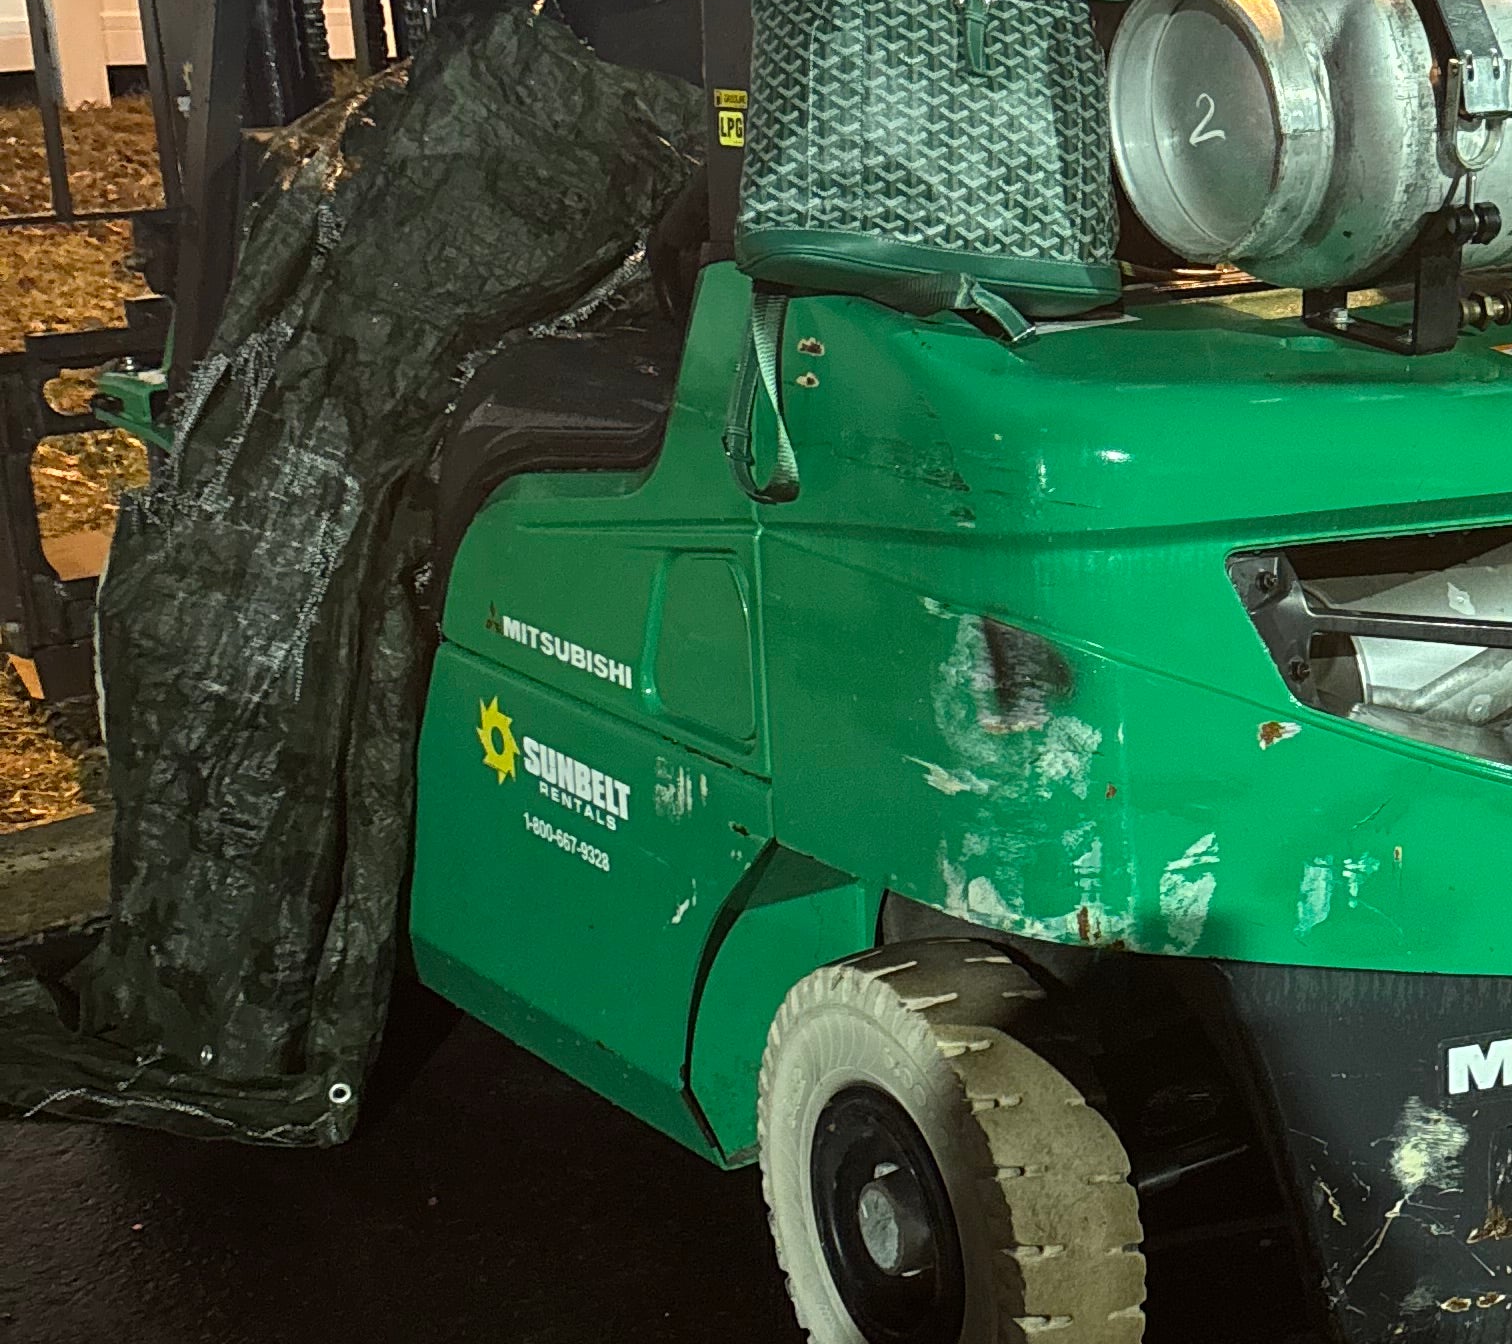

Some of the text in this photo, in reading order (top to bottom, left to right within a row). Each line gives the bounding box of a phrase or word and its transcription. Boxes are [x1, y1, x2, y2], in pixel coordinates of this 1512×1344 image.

[720, 116, 743, 139] LPG
[1188, 92, 1226, 147] 2
[502, 615, 633, 690] MITSUBISHI
[523, 736, 631, 821] SUNBELT
[539, 781, 617, 831] RENTALS
